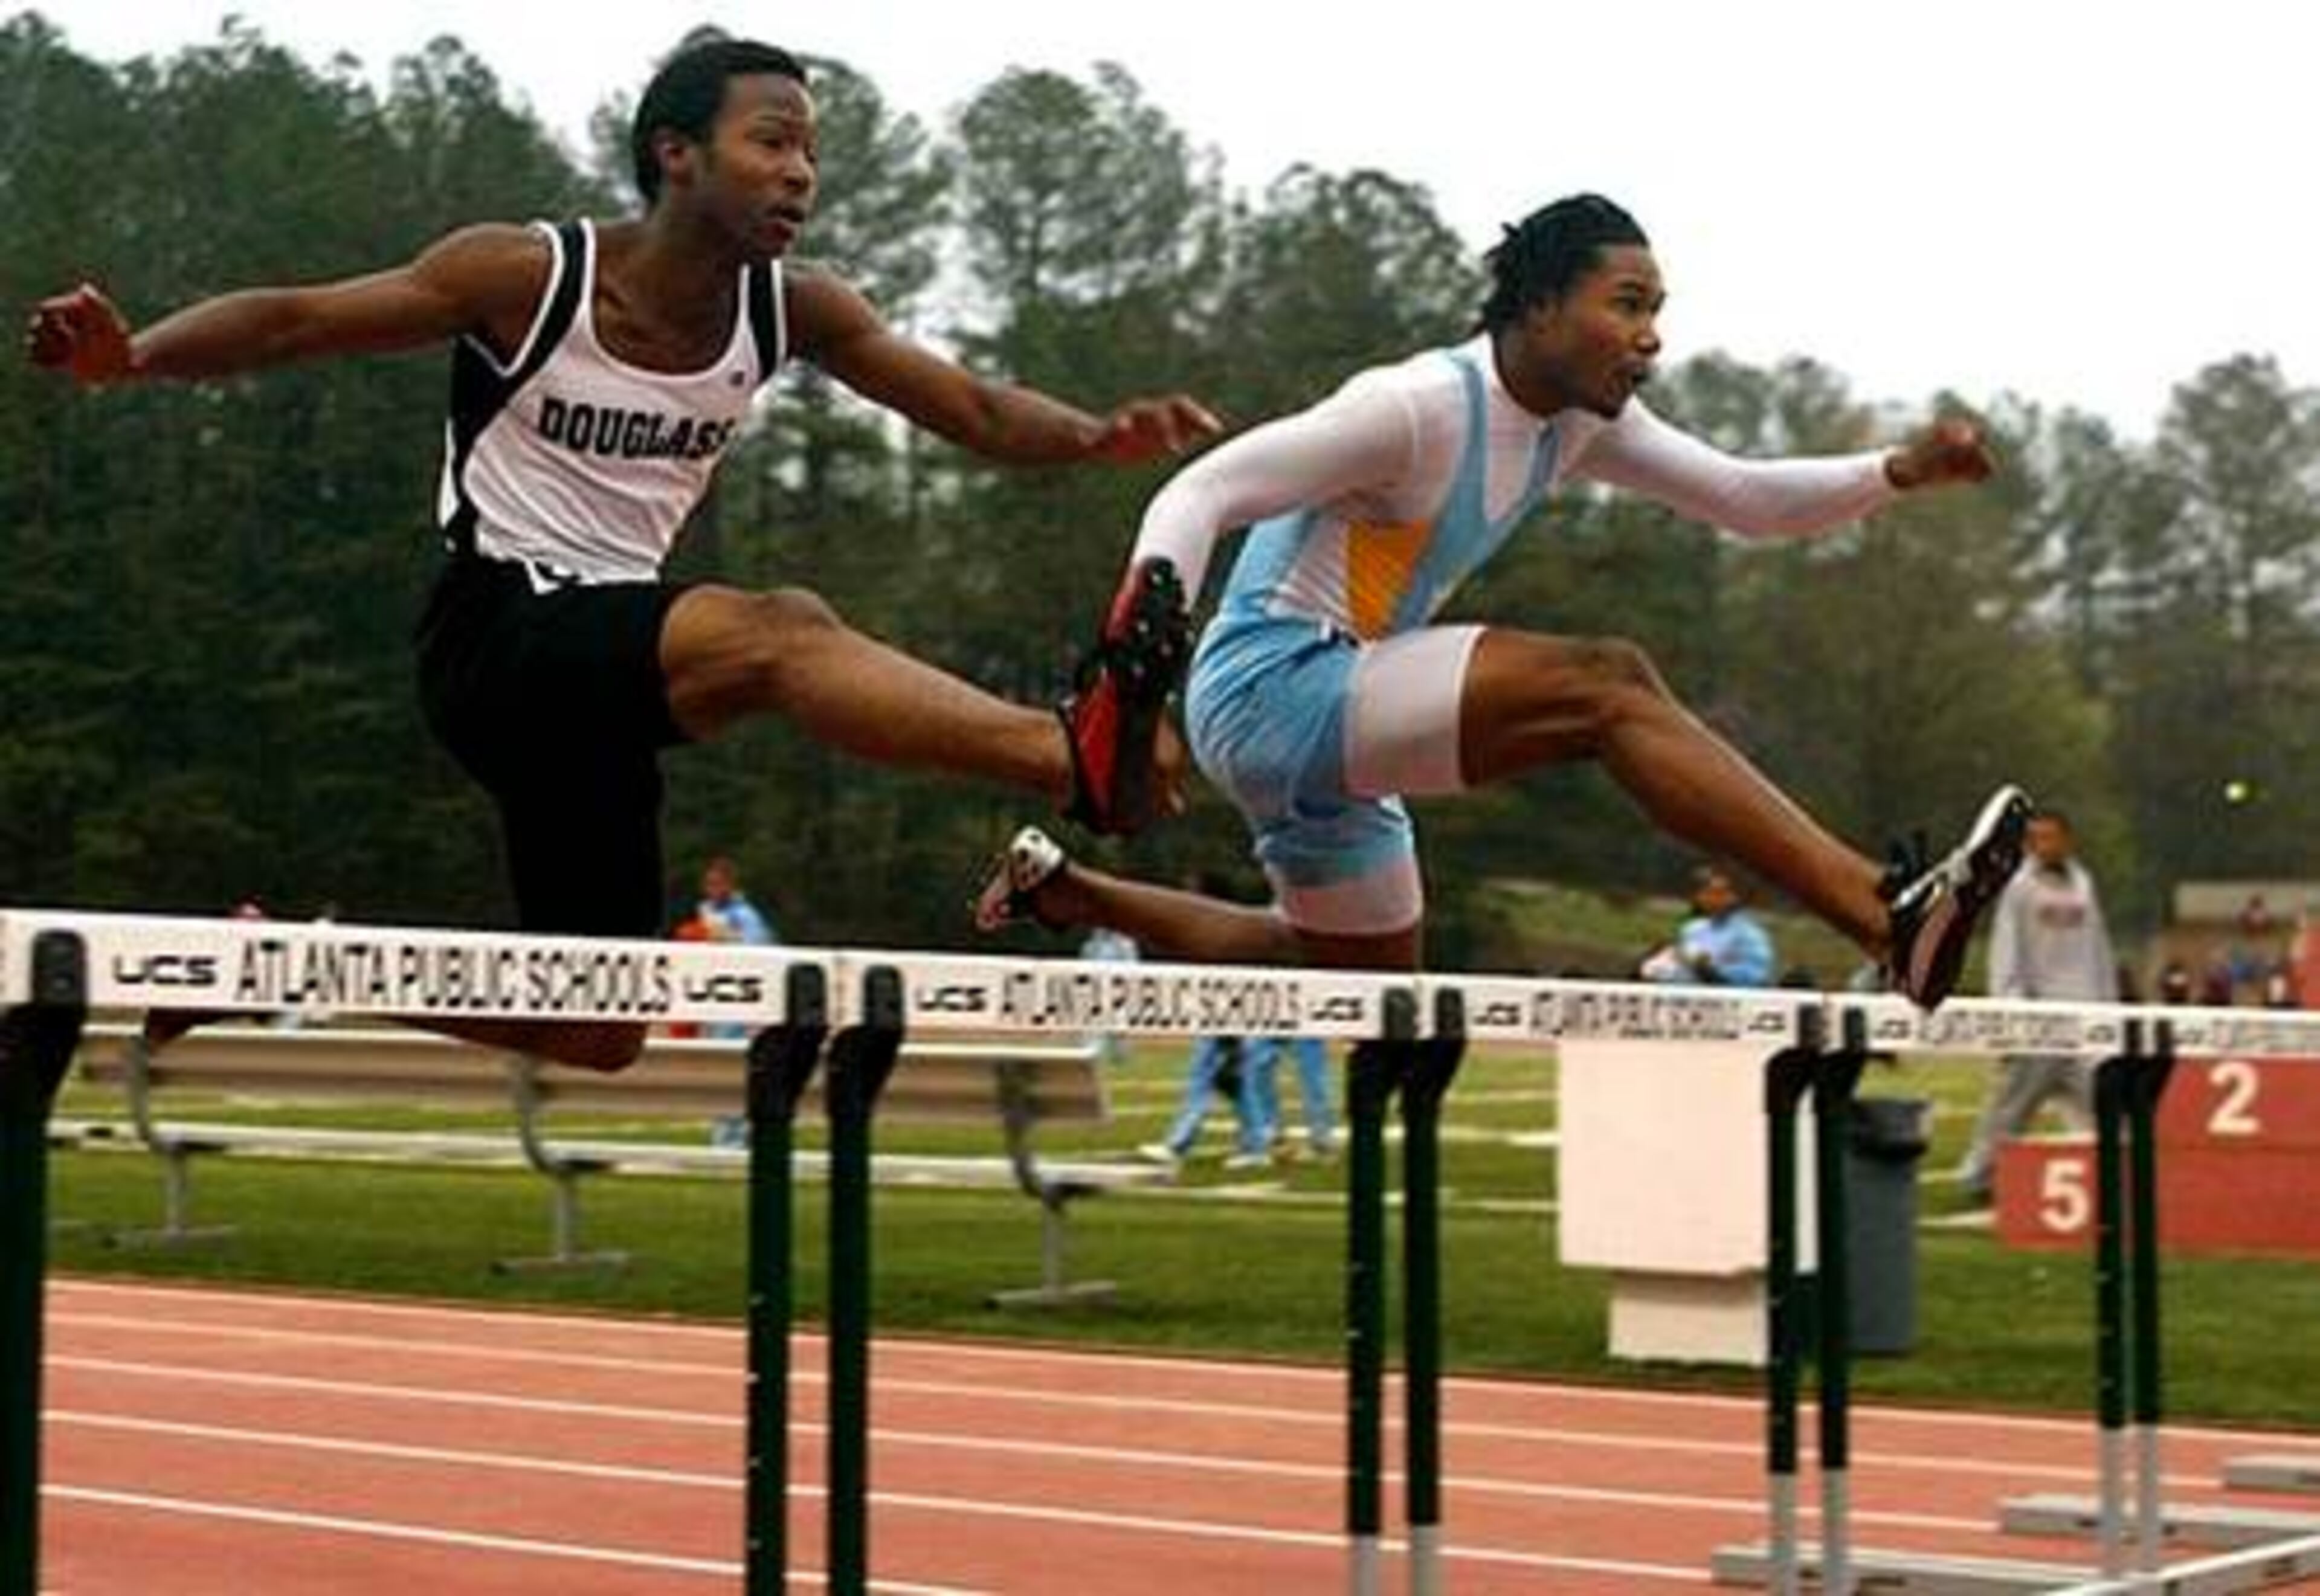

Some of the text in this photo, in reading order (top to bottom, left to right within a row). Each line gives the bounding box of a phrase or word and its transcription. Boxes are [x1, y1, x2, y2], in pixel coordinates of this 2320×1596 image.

[112, 940, 762, 1013] UCS ATLANTA PUBLIC SCHOOLS UCS
[914, 986, 985, 1011] UCS
[1000, 972, 1103, 1025] ATLANTA
[1112, 976, 1190, 1028] PUBLIC
[2207, 1063, 2261, 1135] 2
[2040, 1159, 2090, 1231] 5
